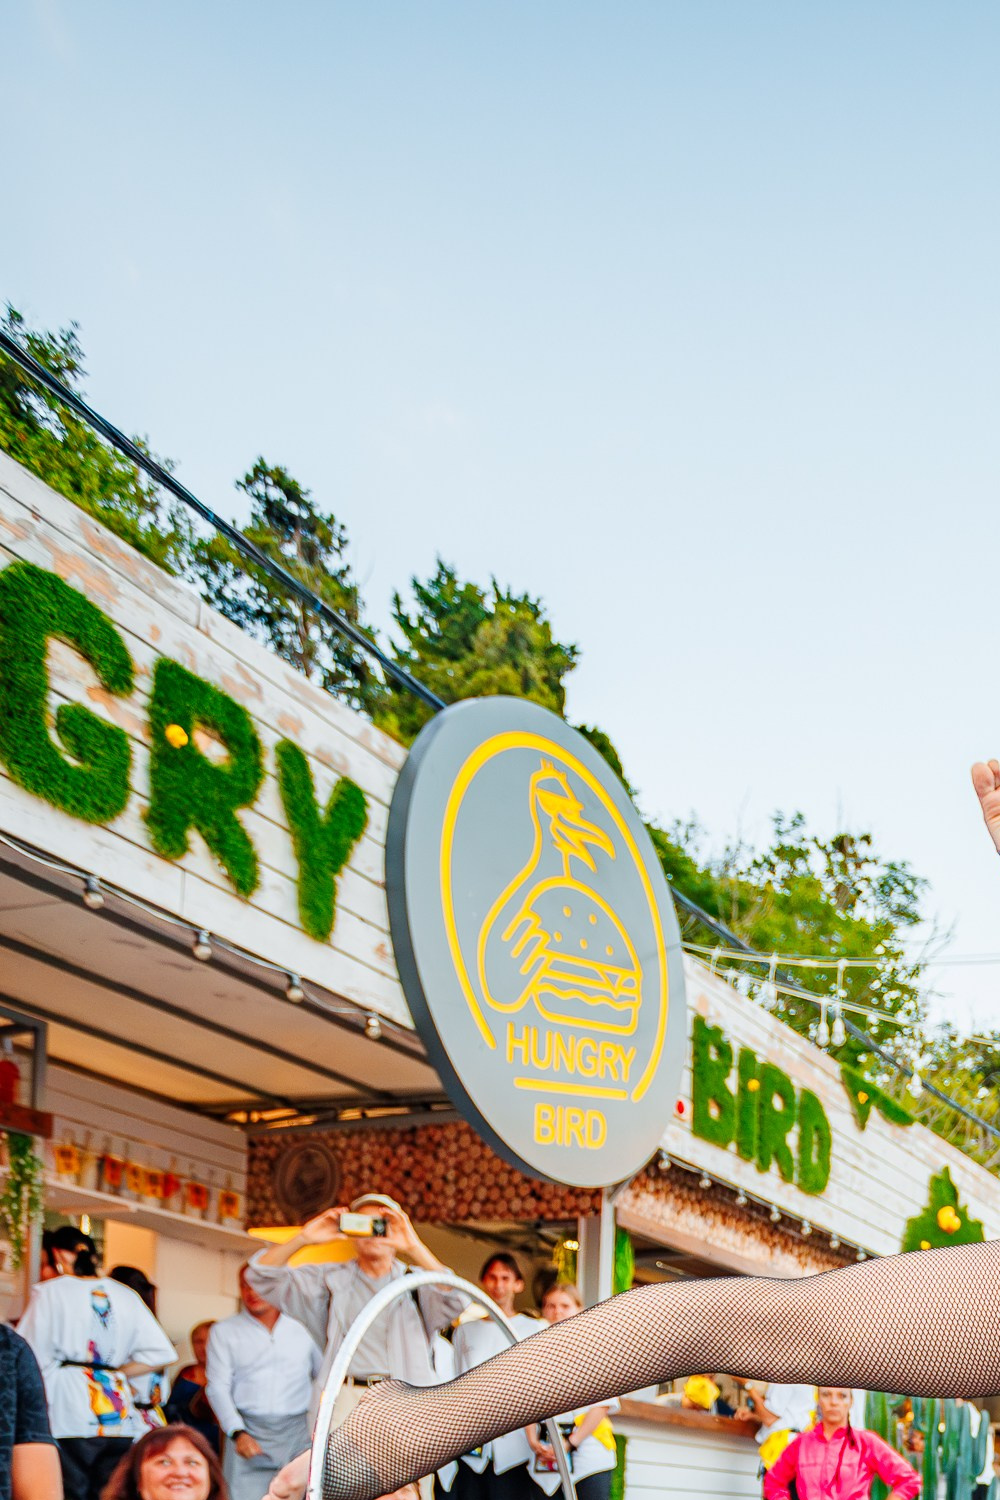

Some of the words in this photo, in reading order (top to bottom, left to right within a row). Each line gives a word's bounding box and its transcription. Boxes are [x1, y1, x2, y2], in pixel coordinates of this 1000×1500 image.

[0, 560, 369, 943] GRY
[692, 1014, 832, 1196] BIRD
[506, 1020, 637, 1083] HUNGRY
[533, 1102, 608, 1150] BIRD
